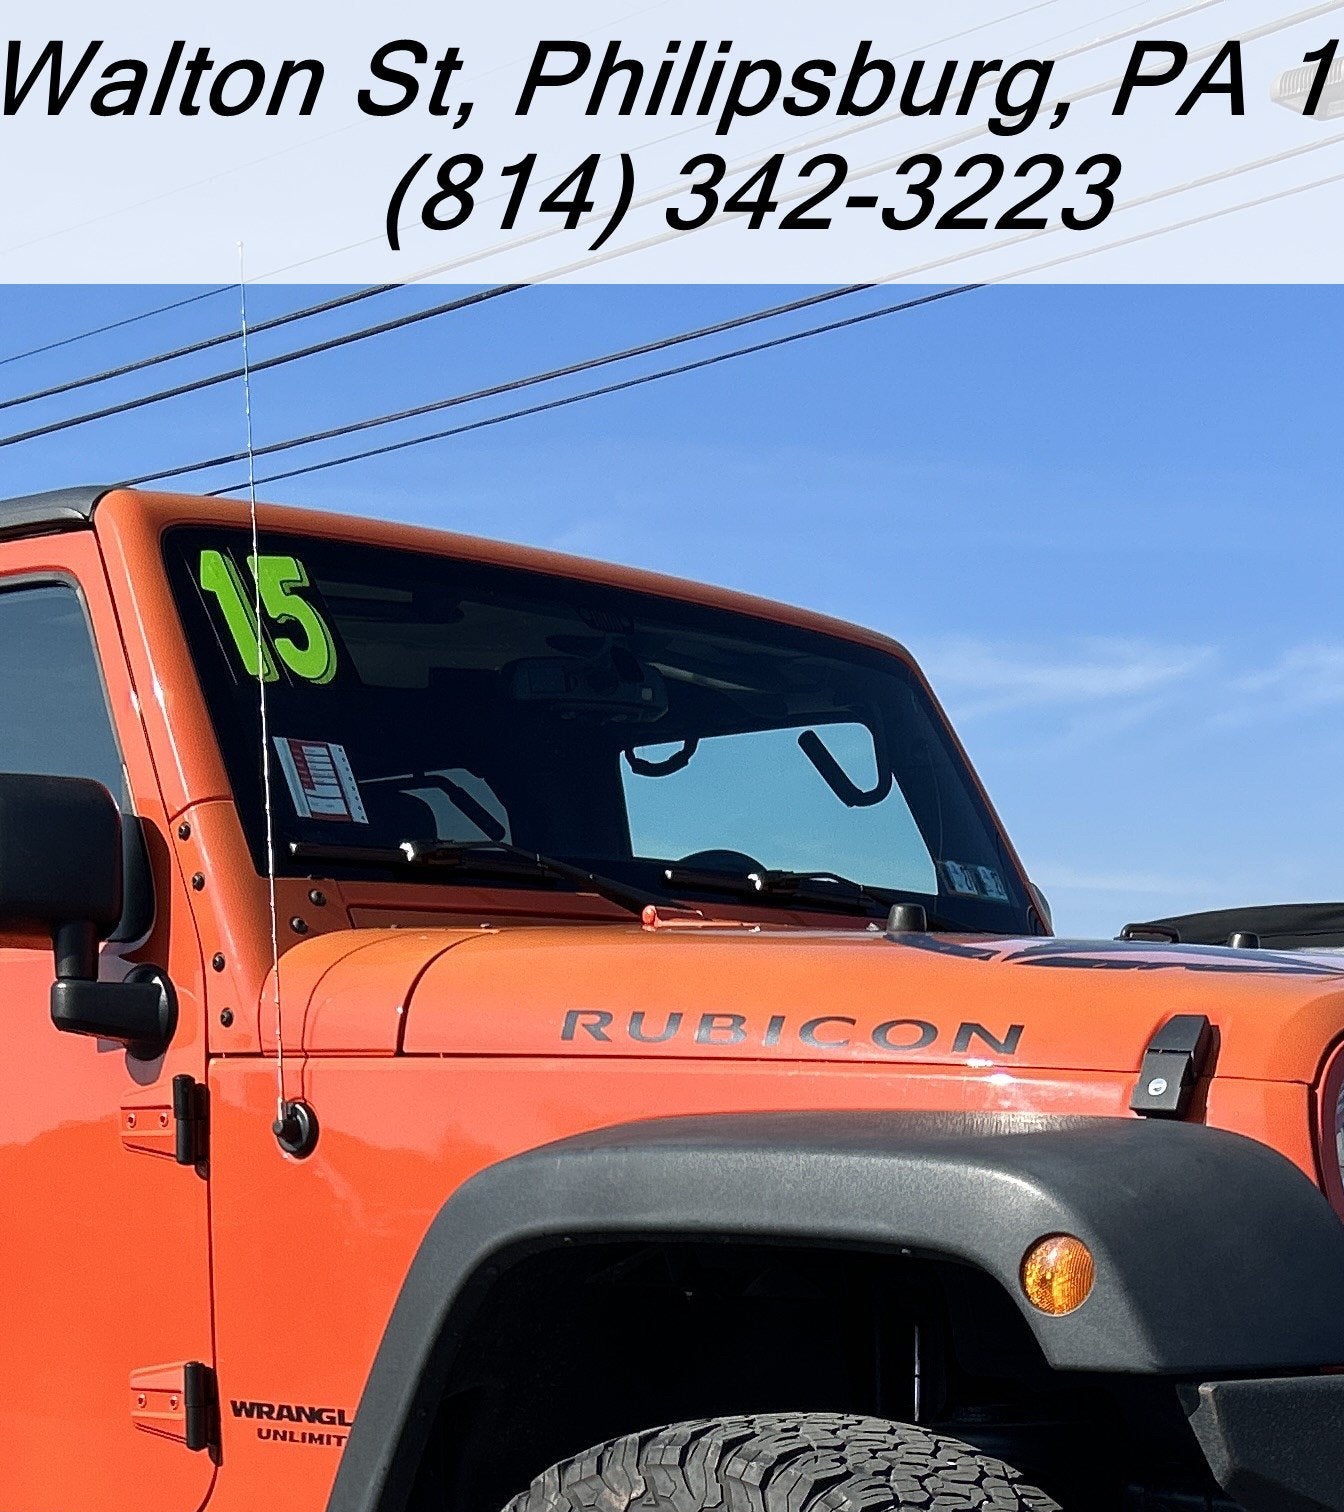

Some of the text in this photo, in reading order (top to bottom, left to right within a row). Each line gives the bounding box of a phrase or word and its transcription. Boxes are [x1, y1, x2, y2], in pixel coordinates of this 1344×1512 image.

[199, 549, 338, 685] 15
[560, 1009, 1025, 1055] RUBICON
[230, 1400, 354, 1427] WRANGL
[257, 1428, 348, 1447] UNLIMIT
